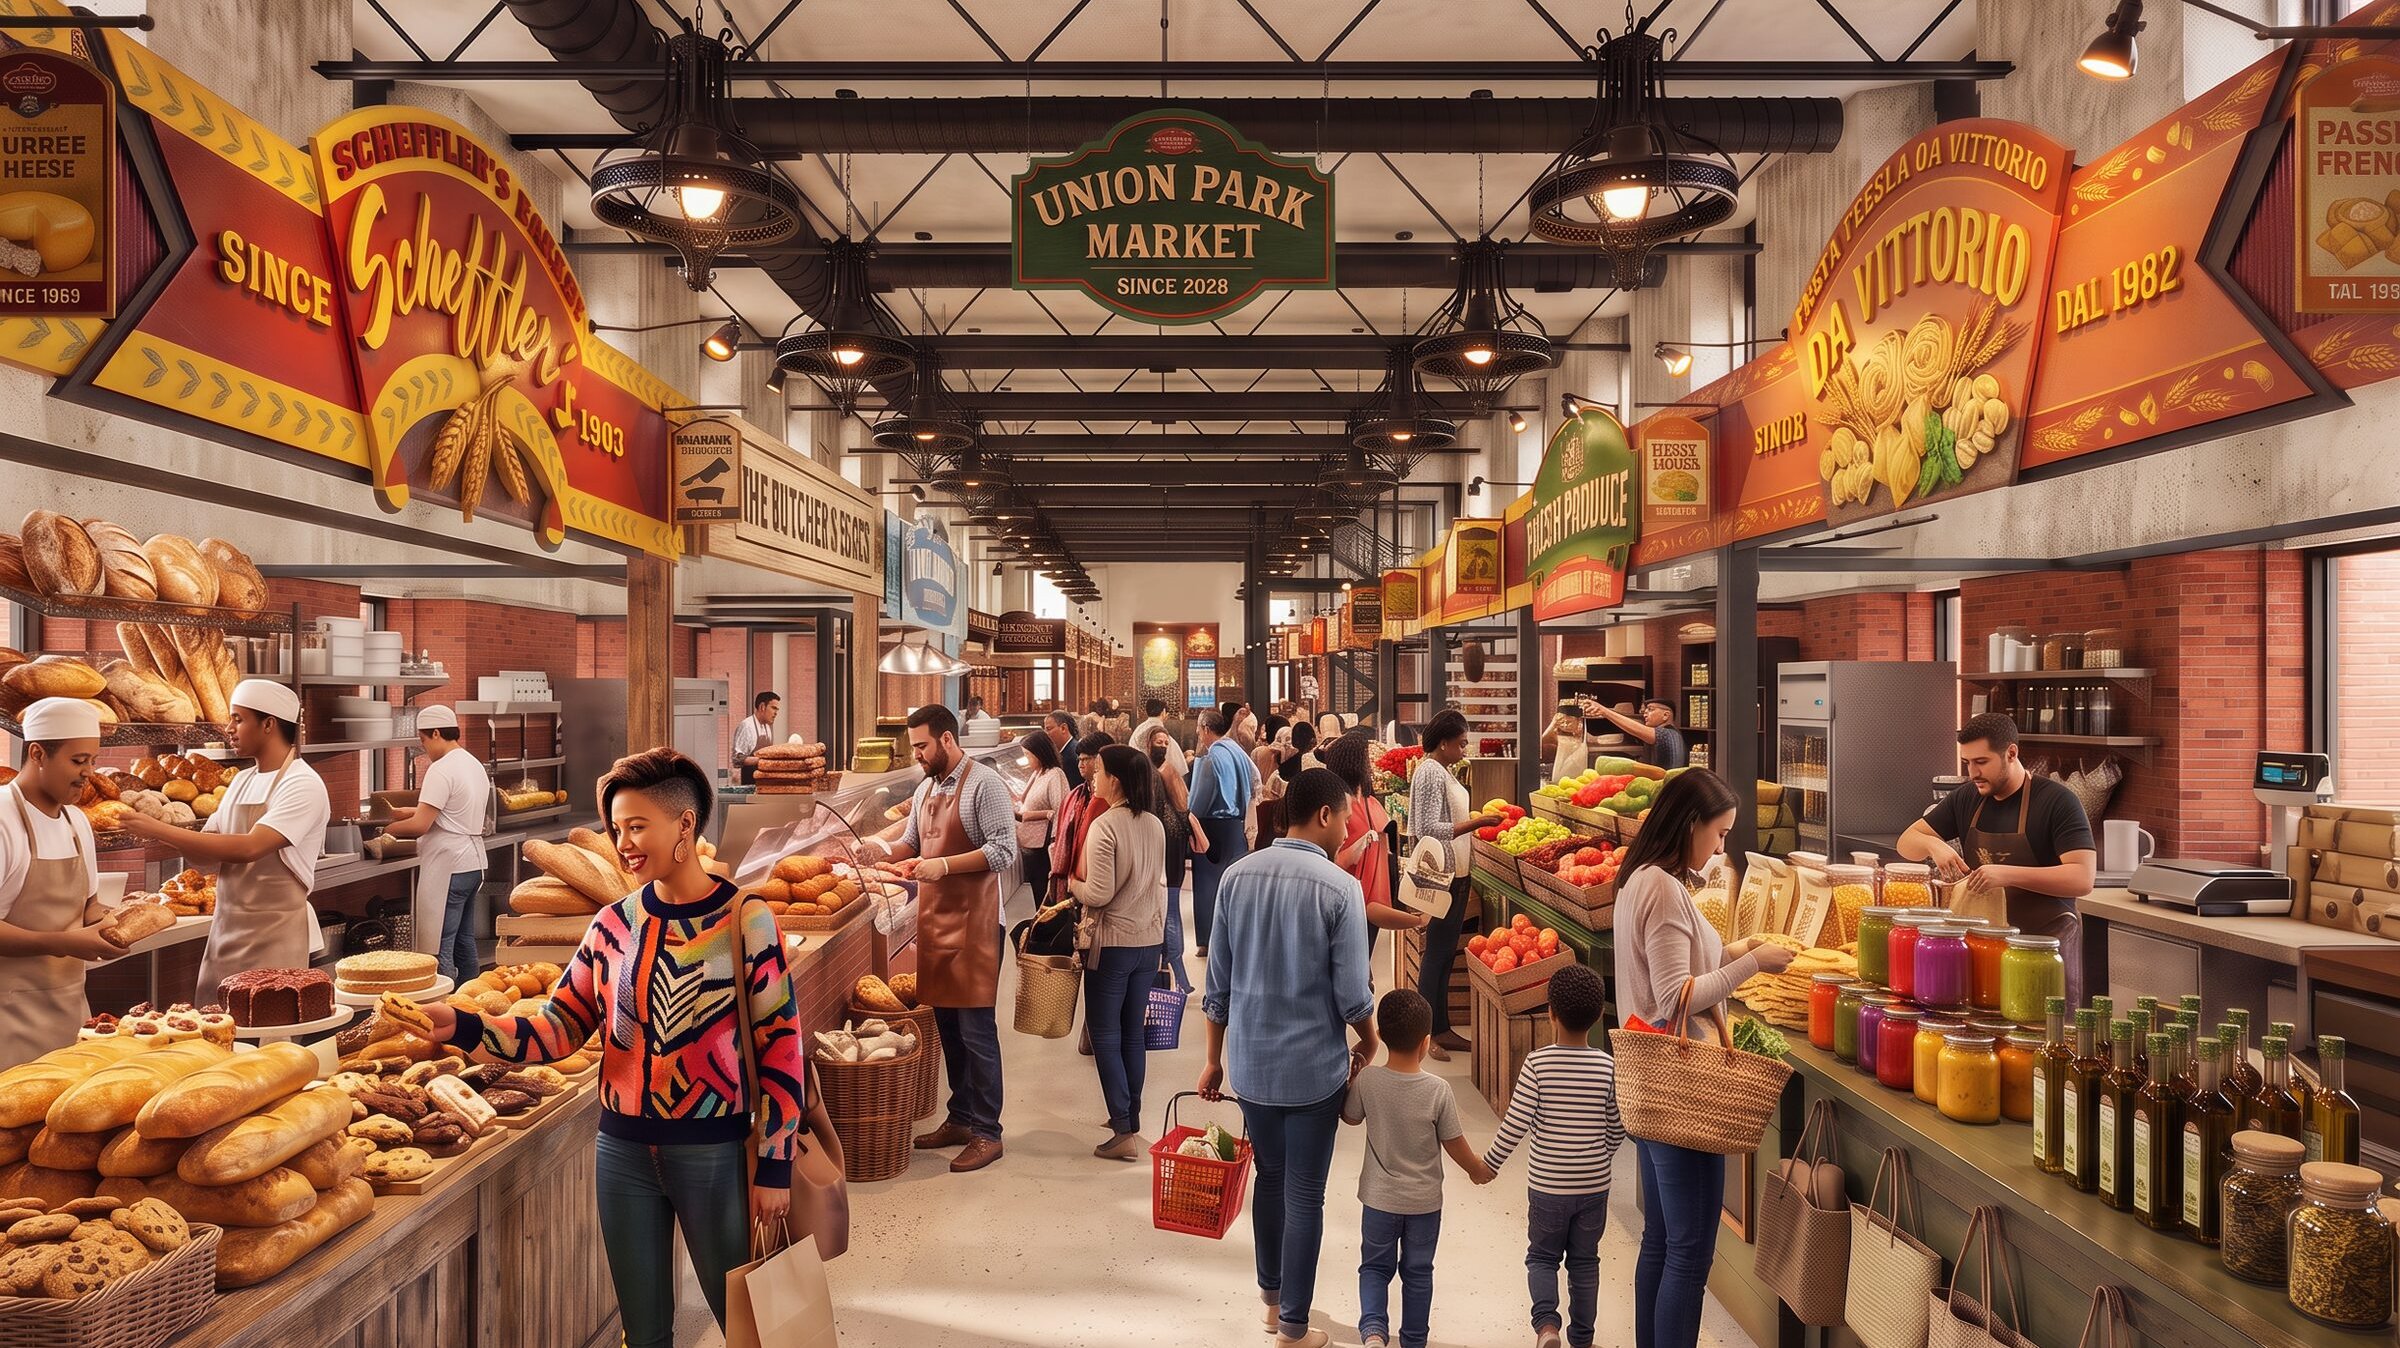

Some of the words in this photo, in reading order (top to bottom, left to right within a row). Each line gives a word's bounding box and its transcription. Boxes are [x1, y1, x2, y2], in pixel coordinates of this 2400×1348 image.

[2, 135, 86, 155] URREE
[2317, 120, 2400, 145] PASS
[4, 159, 75, 179] HEESE
[1949, 132, 2048, 191] VITTORIO
[2317, 151, 2400, 176] FREN
[1030, 164, 1177, 226] UNION
[1190, 164, 1315, 230] PARK
[1085, 223, 1262, 259] MARKET
[41, 288, 81, 304] 1969
[221, 230, 333, 327] SINCE
[1116, 277, 1178, 295] SINCE
[1182, 277, 1230, 295] 2028
[2055, 276, 2106, 334] DAL
[2111, 245, 2178, 312] 1982
[1806, 300, 1852, 399] DA
[1852, 206, 2029, 323] VITTORIO
[580, 409, 625, 457] 1903
[742, 465, 768, 530] THE
